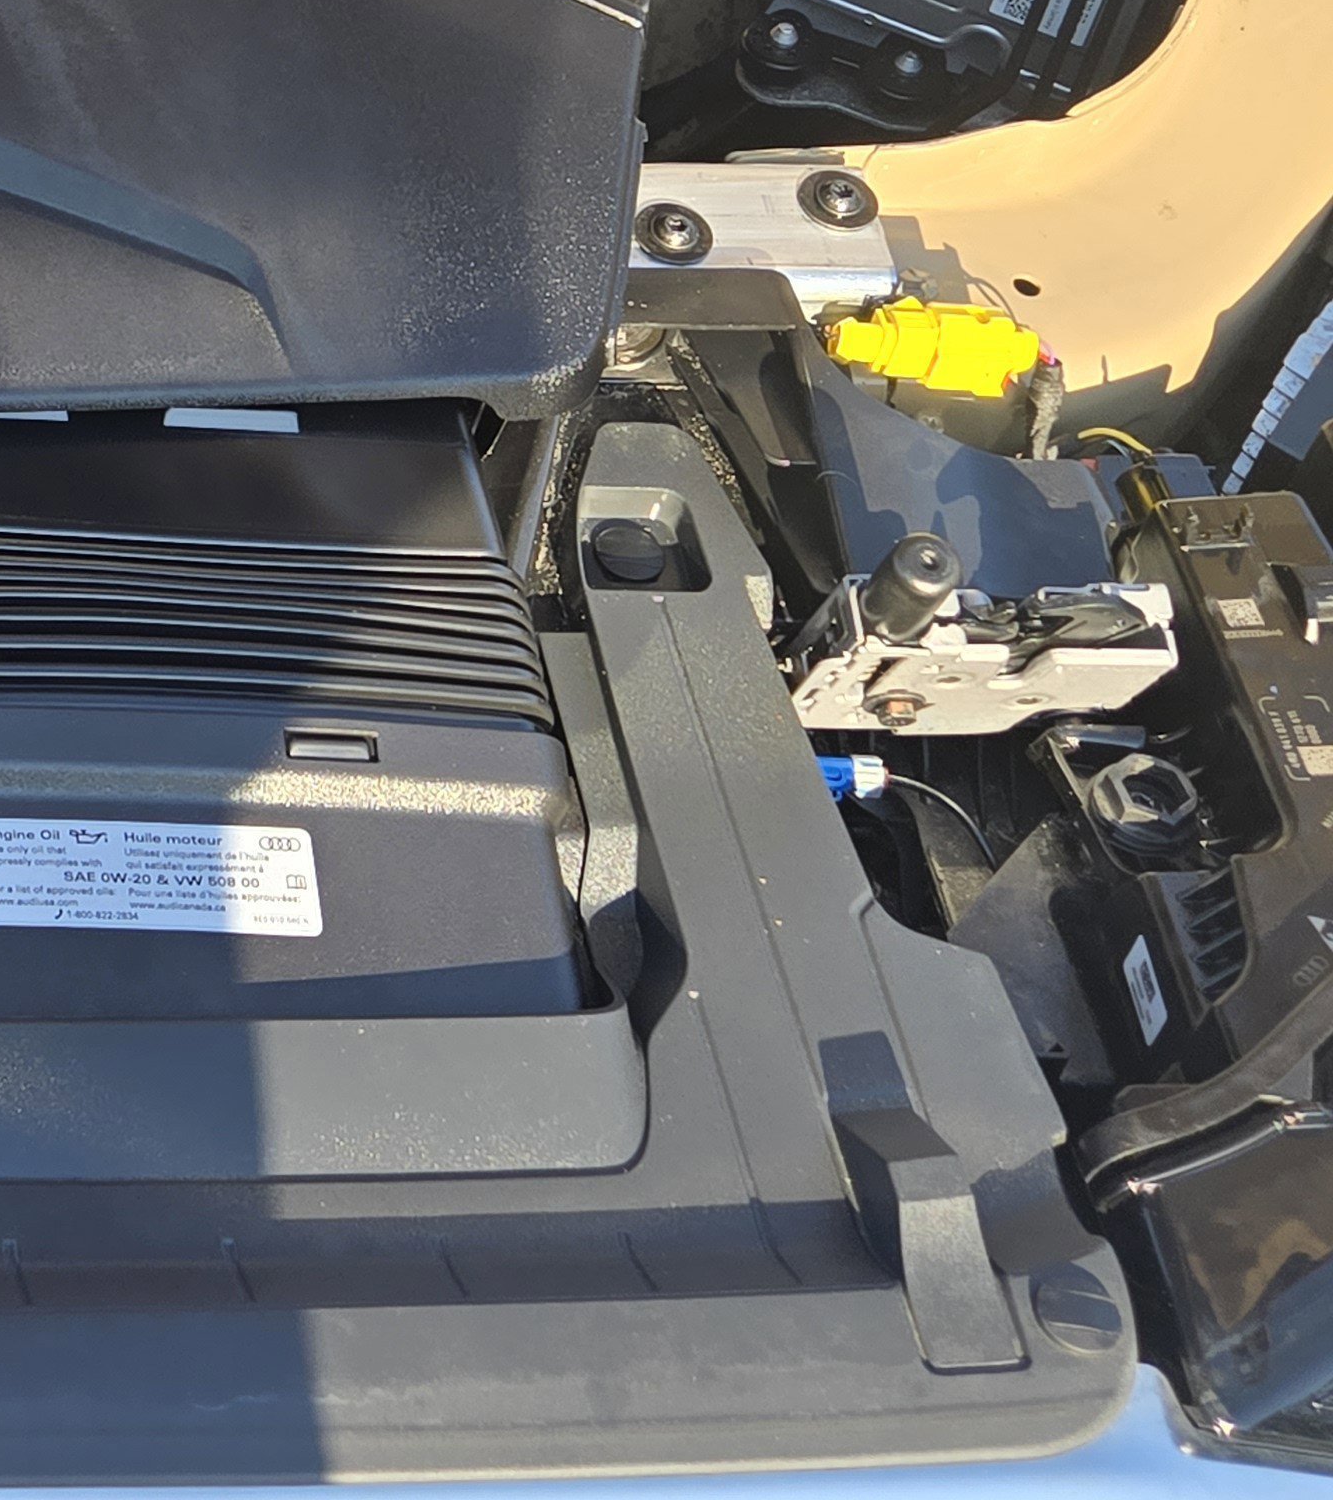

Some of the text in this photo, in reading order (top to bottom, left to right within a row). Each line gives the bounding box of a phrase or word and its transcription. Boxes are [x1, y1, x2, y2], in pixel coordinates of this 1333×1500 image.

[40, 829, 60, 840] Oil
[124, 832, 161, 844] Huile
[166, 834, 223, 846] moteur
[7, 844, 29, 855] only
[32, 845, 45, 854] oil
[46, 845, 67, 855] that
[124, 848, 270, 862] Utilisez uniquement de l'huile
[34, 857, 79, 868] complies
[80, 858, 103, 868] with
[125, 861, 142, 871] qui
[145, 861, 183, 871] satisfait
[258, 865, 264, 873] à
[64, 871, 260, 889] SAE 0W-20 & VW 508 00
[7, 886, 13, 894] a
[15, 885, 31, 894] list
[33, 885, 44, 894] of
[46, 886, 94, 897] approved
[128, 887, 152, 897] Pour
[154, 890, 172, 898] une
[175, 889, 197, 899] liste
[129, 901, 226, 912] www.audicanada.ca
[67, 909, 139, 921] 1-800-822-2834
